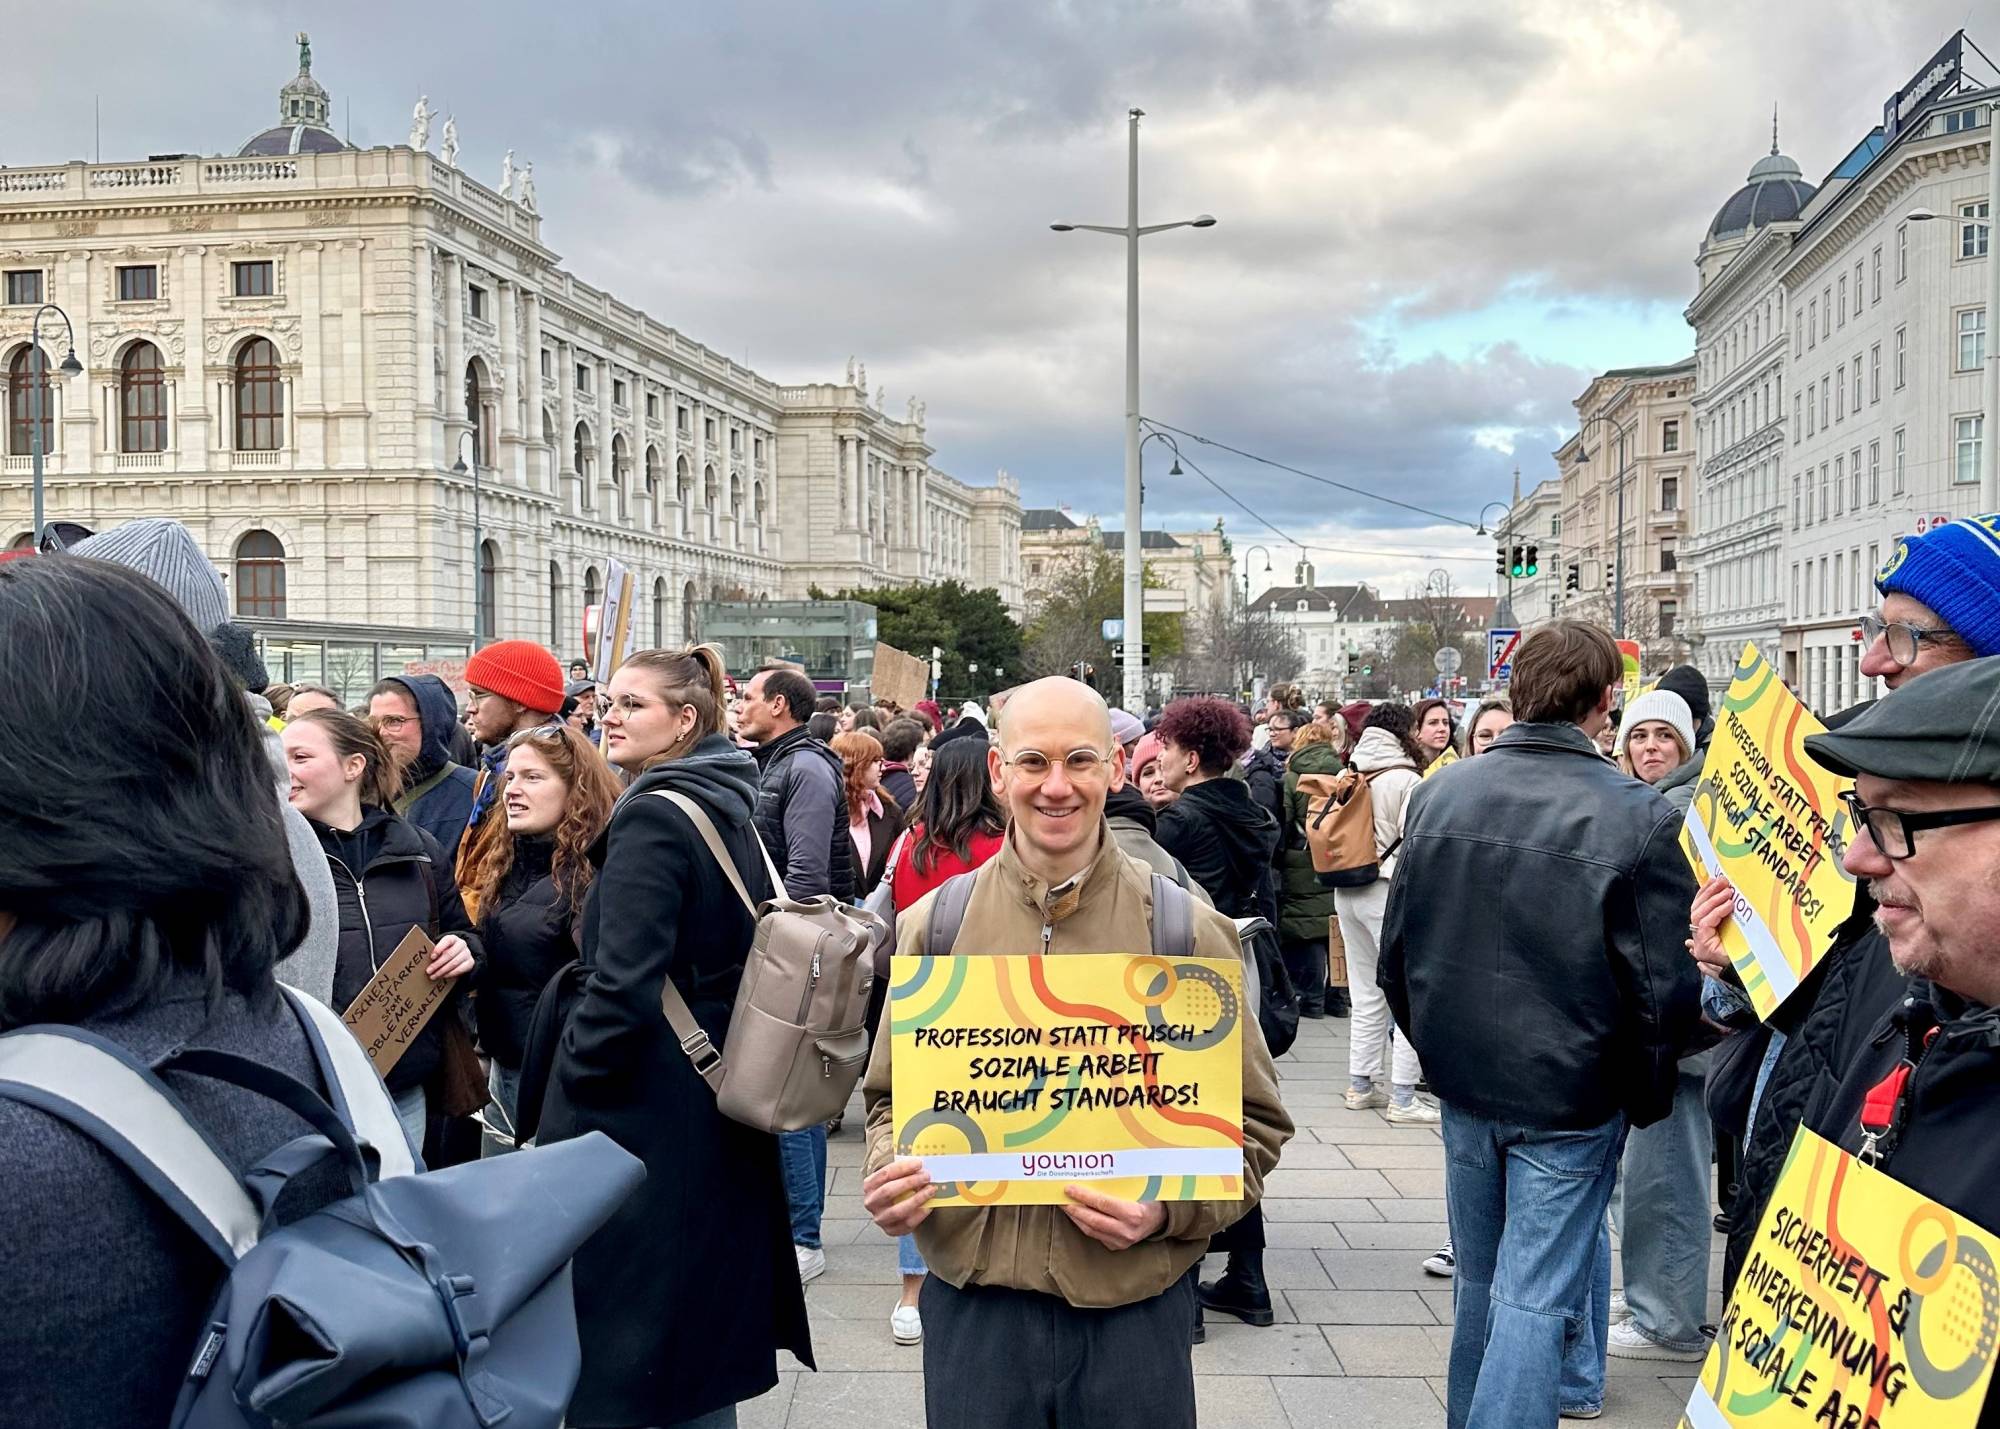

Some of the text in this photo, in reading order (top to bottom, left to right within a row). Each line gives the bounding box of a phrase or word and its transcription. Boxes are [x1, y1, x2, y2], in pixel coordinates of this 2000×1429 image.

[1107, 622, 1119, 638] U
[1726, 710, 1848, 862] PROFESSION STATT PFUSC
[1711, 769, 1824, 924] BRAUCHT STANDARDS!
[1730, 761, 1826, 874] SOZIALE ARBEIT
[368, 997, 414, 1058] OBLEME
[382, 995, 402, 1022] statt
[395, 979, 447, 1043] VERWALTE
[915, 1028, 1040, 1049] PROFESSION
[1049, 1025, 1111, 1046] STATT
[1118, 1024, 1195, 1045] PFUSCH
[970, 1052, 1164, 1079] SOZIALE ARBEIT
[933, 1083, 1199, 1115] BRAUCHT STANDARDS!
[1022, 1153, 1114, 1176] younion
[1770, 1207, 1912, 1341] SICHERHEIT &
[1744, 1252, 1908, 1407] ANERKENNUNG
[1736, 1316, 1818, 1409] SOZIALE
